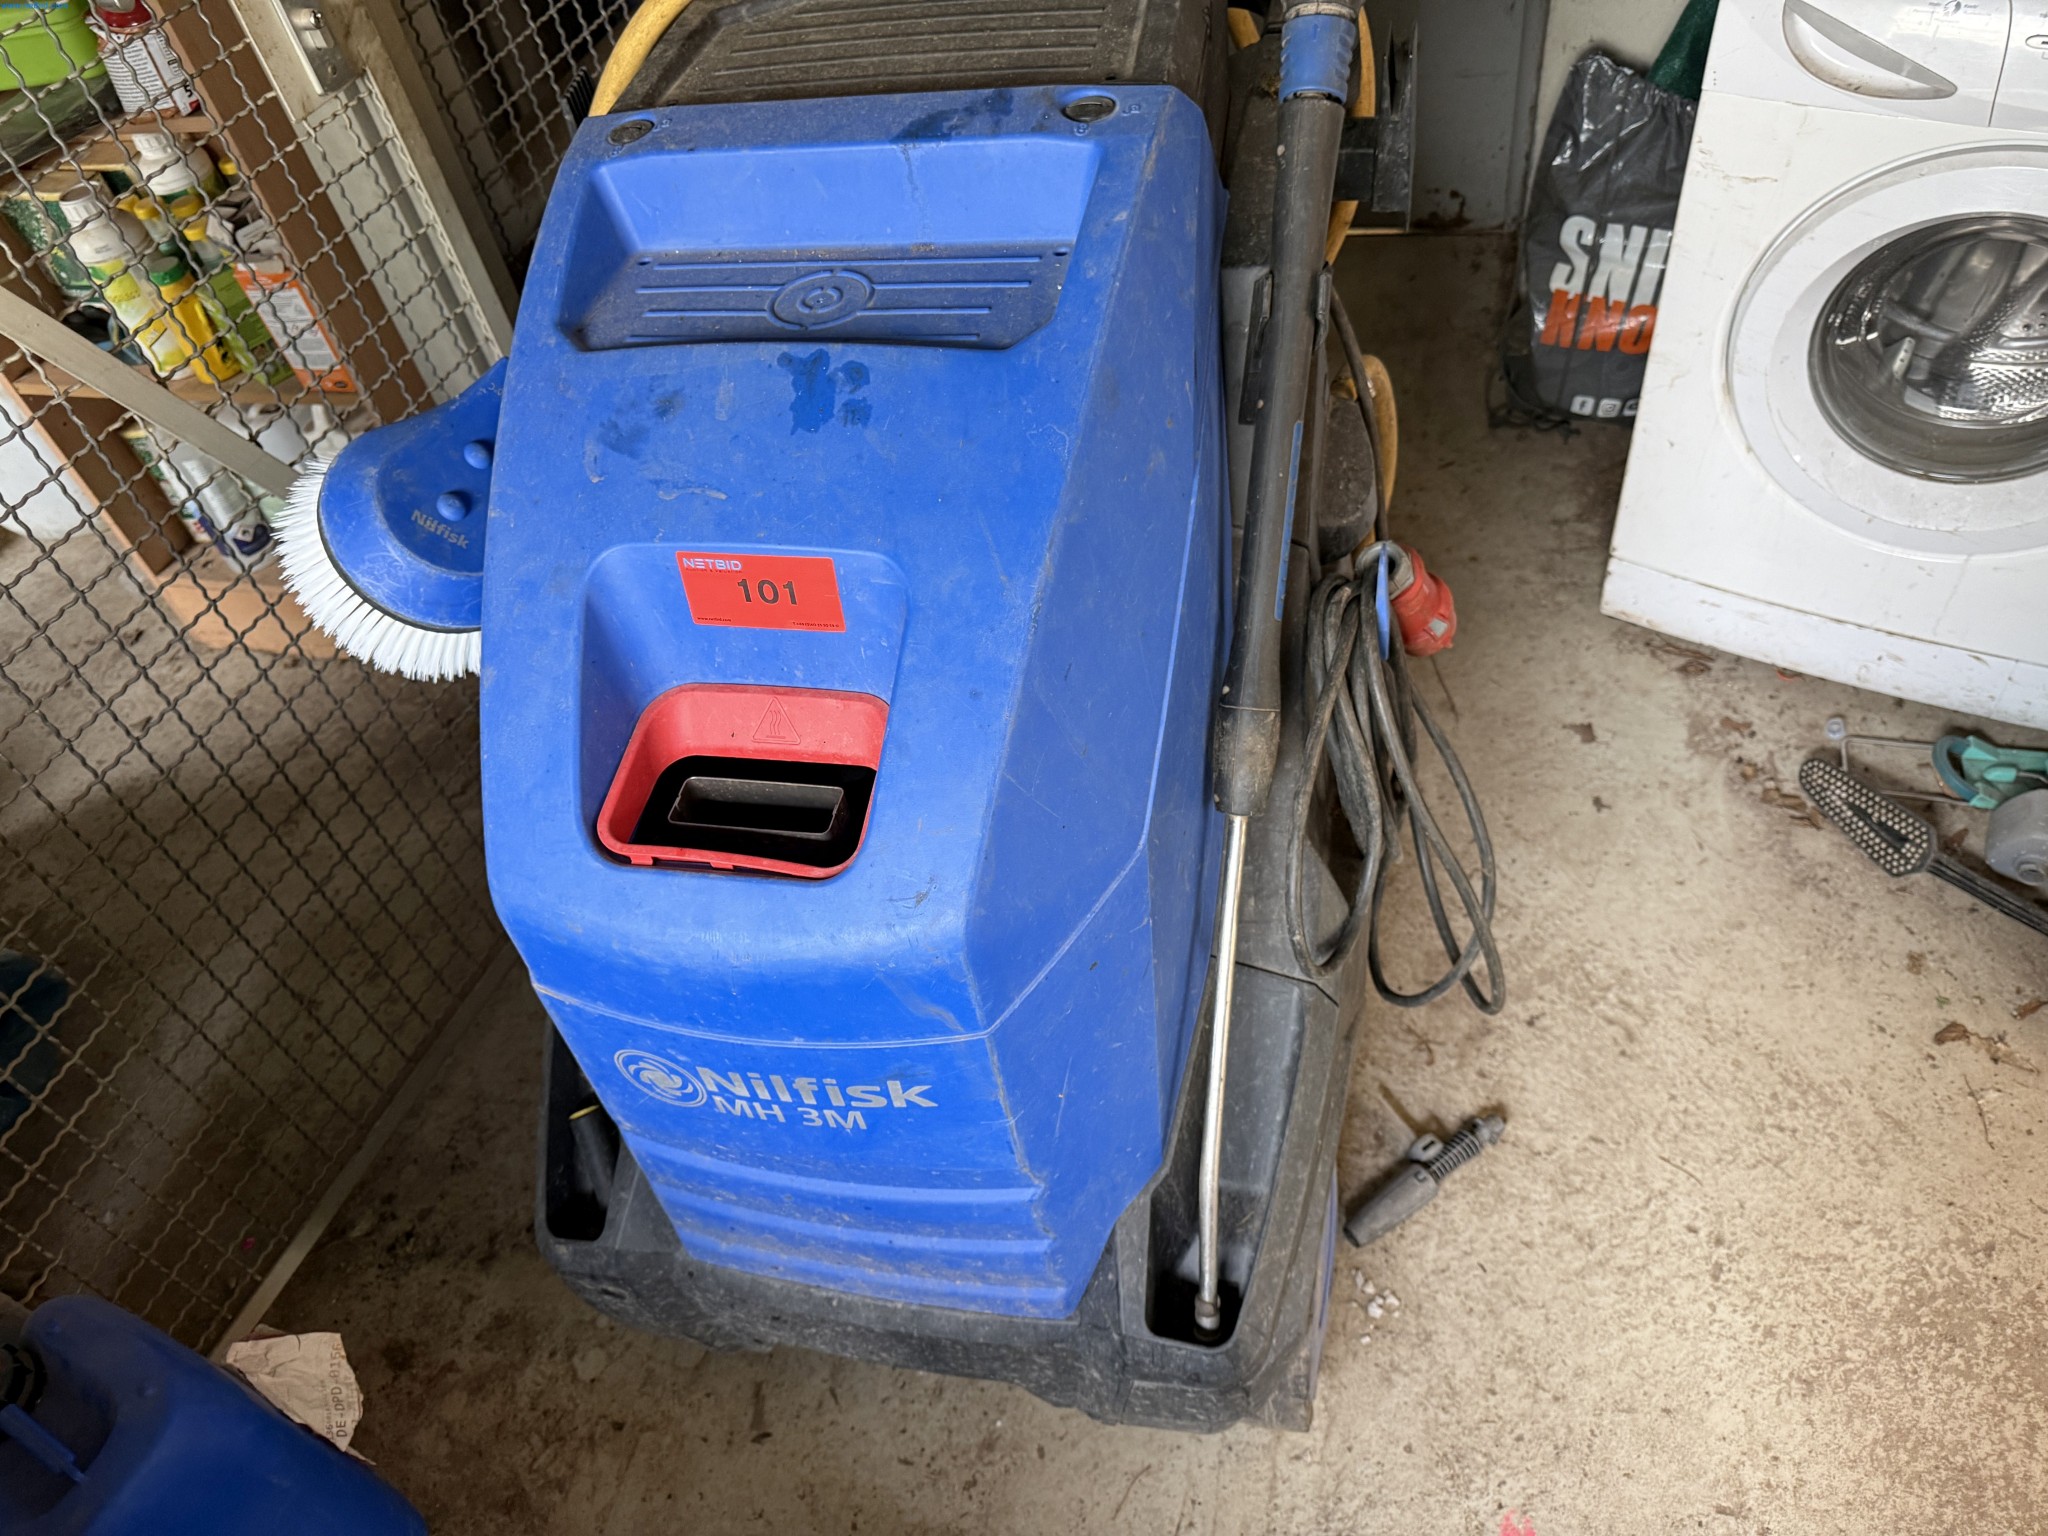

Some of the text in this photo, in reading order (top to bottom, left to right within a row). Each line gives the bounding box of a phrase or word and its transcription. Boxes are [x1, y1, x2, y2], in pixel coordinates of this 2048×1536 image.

[411, 509, 470, 549] Nilfisk
[682, 557, 742, 571] NETBID
[737, 578, 797, 605] 101
[696, 1066, 938, 1109] Nilfisk
[713, 1096, 867, 1130] MH 3M
